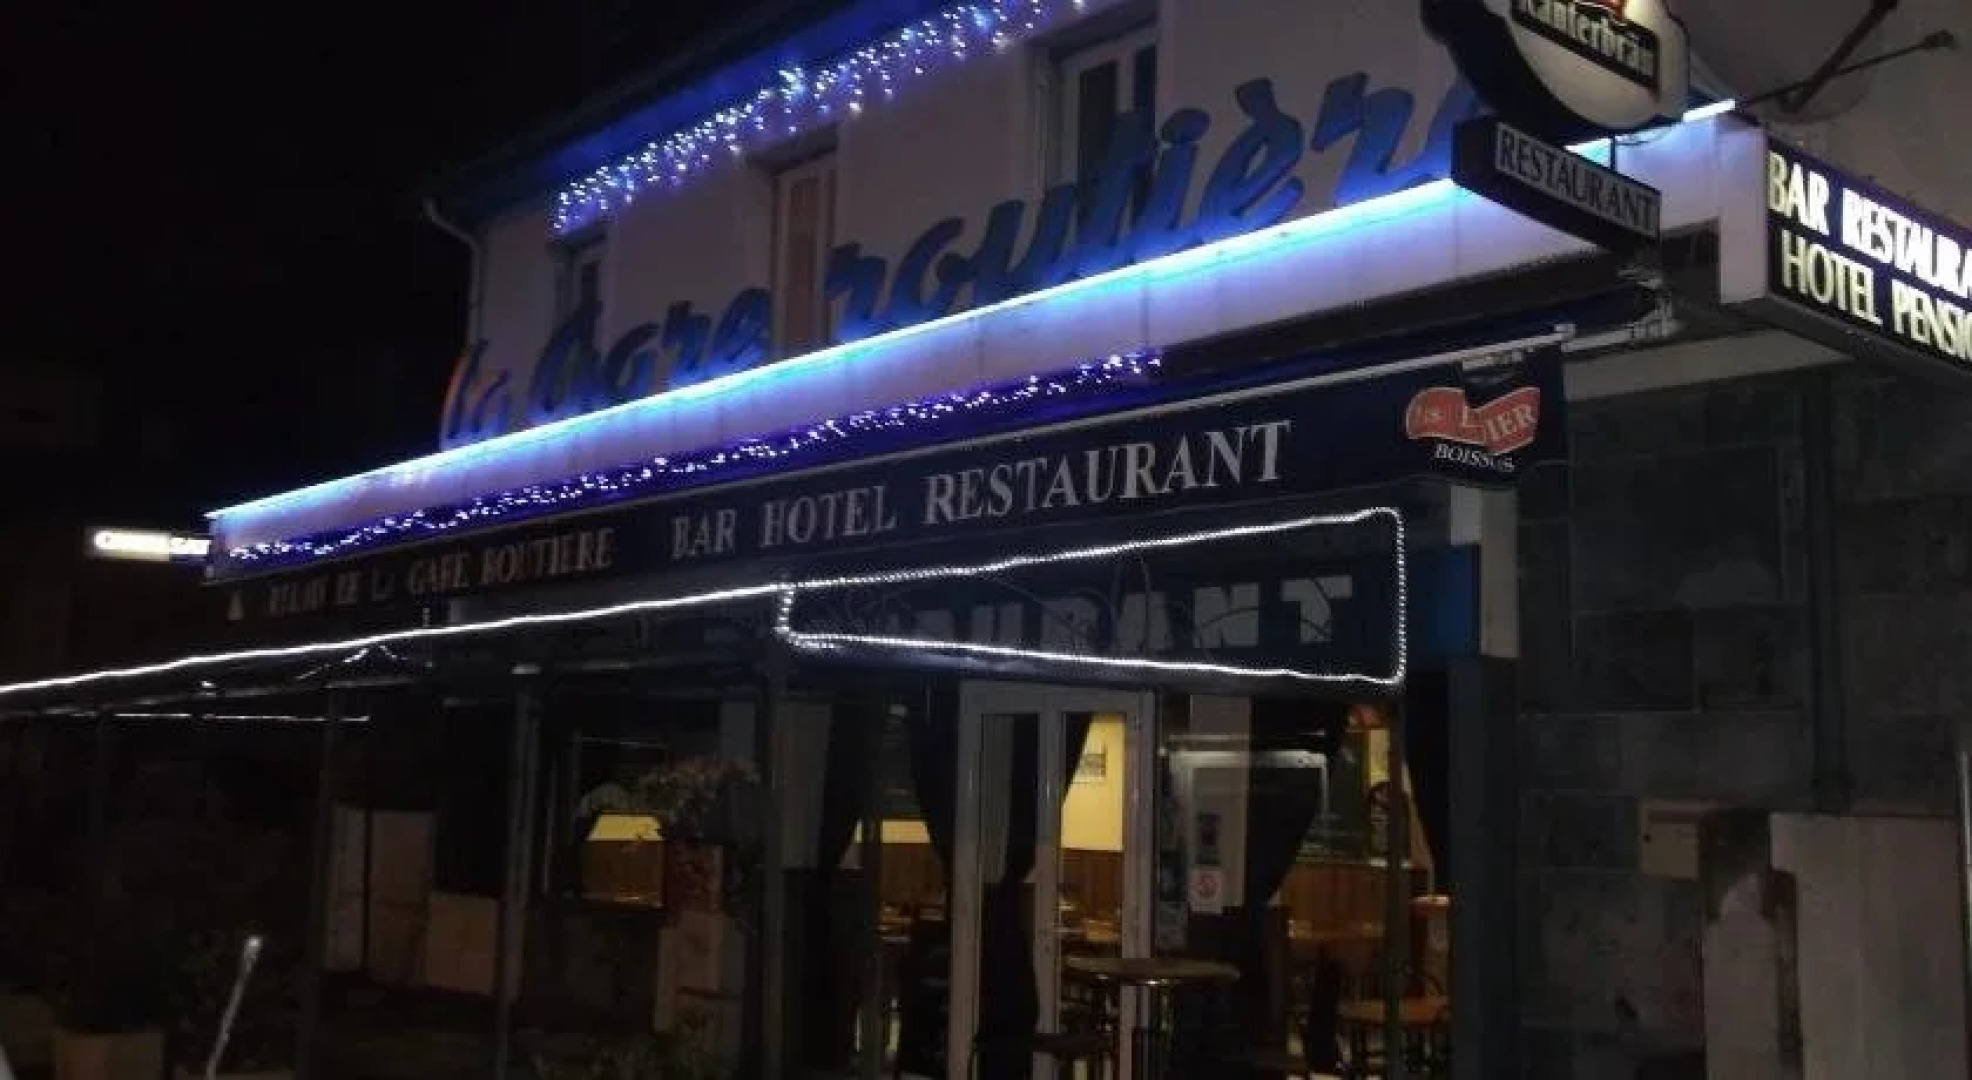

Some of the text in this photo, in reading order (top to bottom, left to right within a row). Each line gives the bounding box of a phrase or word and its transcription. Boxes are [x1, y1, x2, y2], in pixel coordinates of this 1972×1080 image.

[1502, 130, 1656, 238] RESTAURANT
[1768, 151, 1830, 236] BAR
[1782, 228, 1883, 325] HOTEL
[670, 507, 737, 561] BAR
[760, 485, 896, 548] HOTEL
[923, 420, 1292, 526] RESTAURANT
